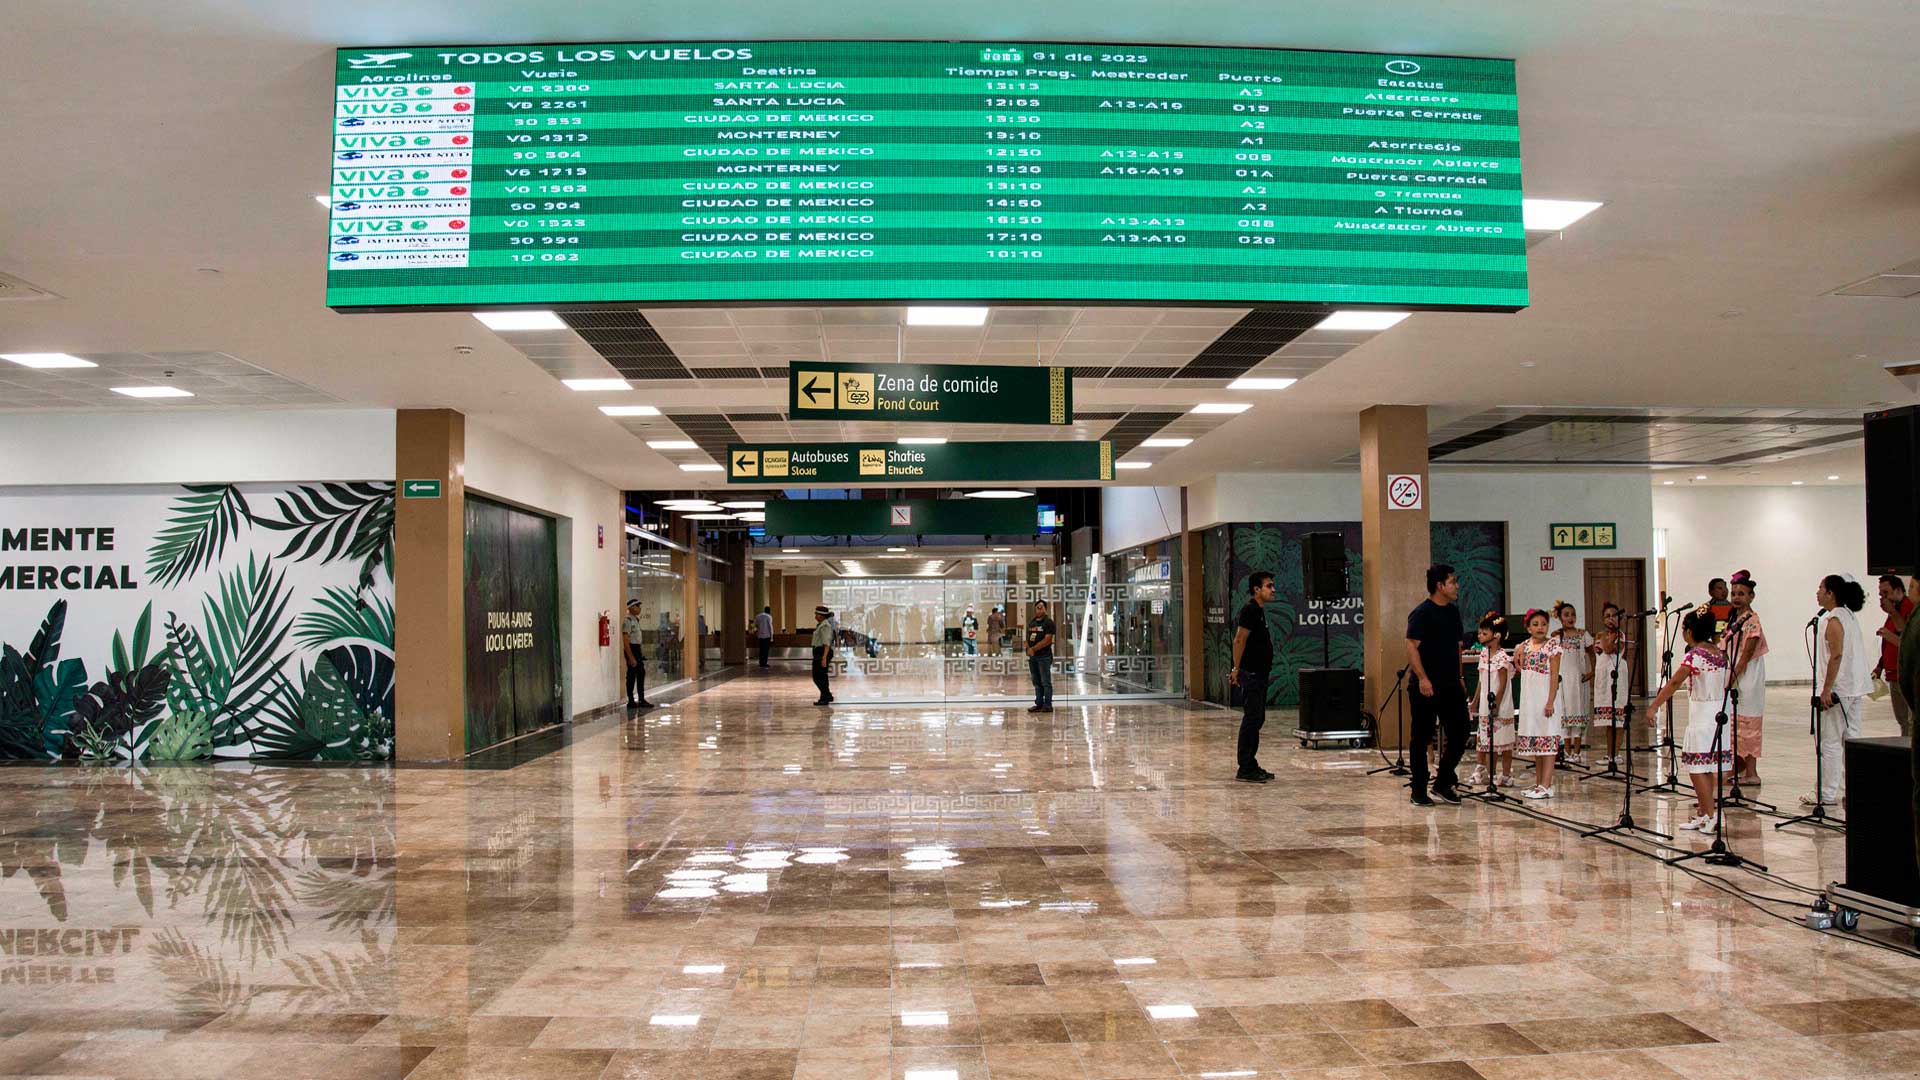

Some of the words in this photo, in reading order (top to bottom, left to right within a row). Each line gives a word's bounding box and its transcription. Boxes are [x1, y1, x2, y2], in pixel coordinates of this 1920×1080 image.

[437, 51, 545, 65] TODOS
[557, 49, 615, 62] LOS
[626, 48, 753, 61] VUELOS
[712, 97, 780, 106] SANTA
[786, 97, 845, 106] LUCIA
[765, 114, 792, 122] DE
[765, 147, 791, 156] DE
[765, 181, 791, 190] DE
[766, 198, 792, 207] DE
[1374, 206, 1388, 214] A
[765, 215, 791, 224] DE
[765, 232, 792, 241] DE
[986, 232, 1042, 241] 17:10
[765, 249, 790, 258] DE
[877, 374, 915, 391] Zena
[919, 374, 939, 392] de
[943, 376, 999, 394] comide
[909, 398, 940, 411] Court
[791, 450, 849, 463] Autobuses
[2, 528, 115, 551] MENTE
[1541, 558, 1553, 570] PU
